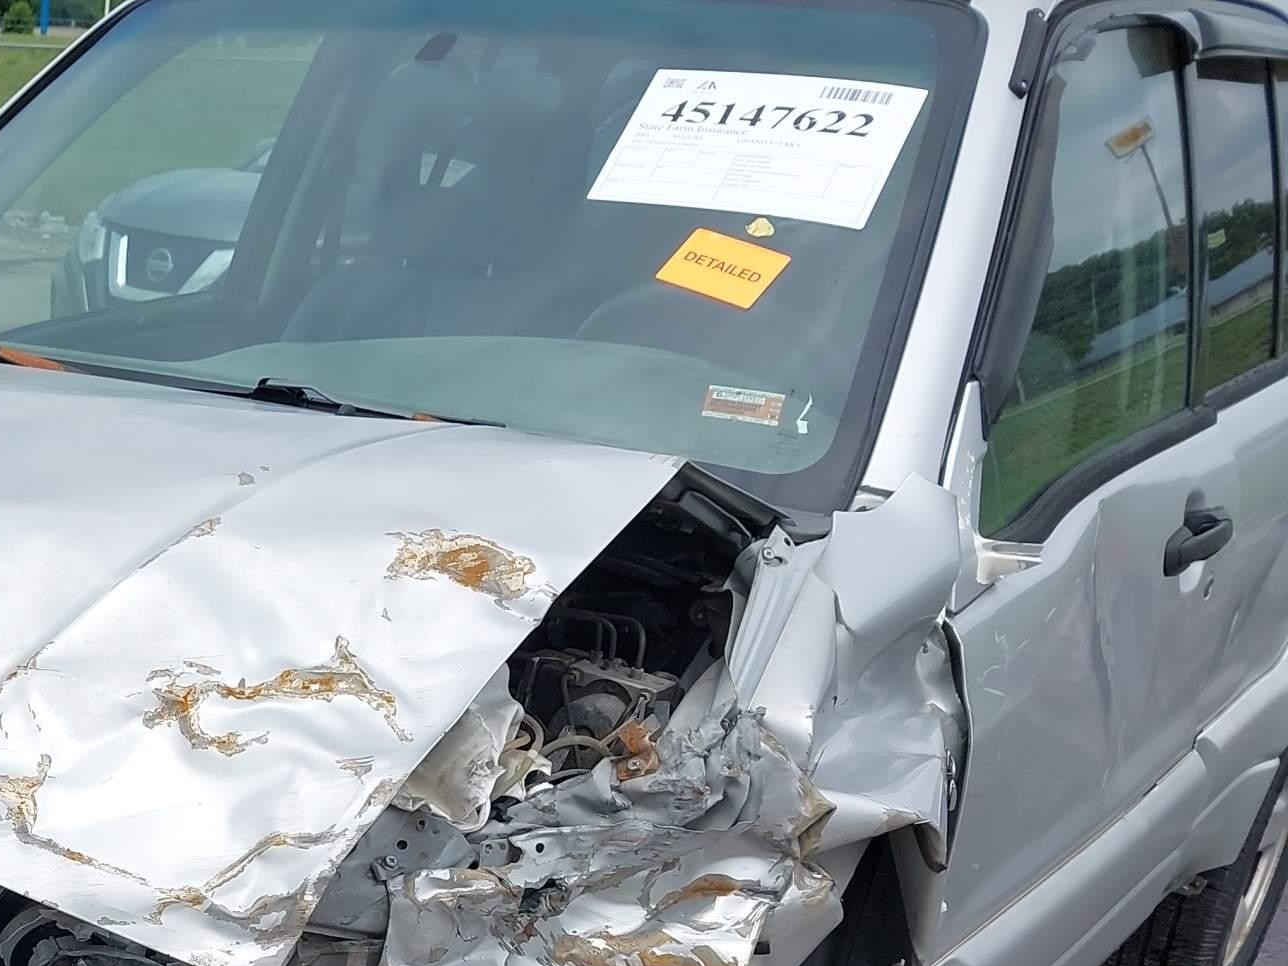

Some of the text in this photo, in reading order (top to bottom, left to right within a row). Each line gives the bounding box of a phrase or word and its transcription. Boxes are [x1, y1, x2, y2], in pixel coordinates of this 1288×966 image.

[639, 122, 749, 136] State Farm Insurance
[661, 100, 874, 137] 45147622
[683, 250, 762, 283] DETAILED
